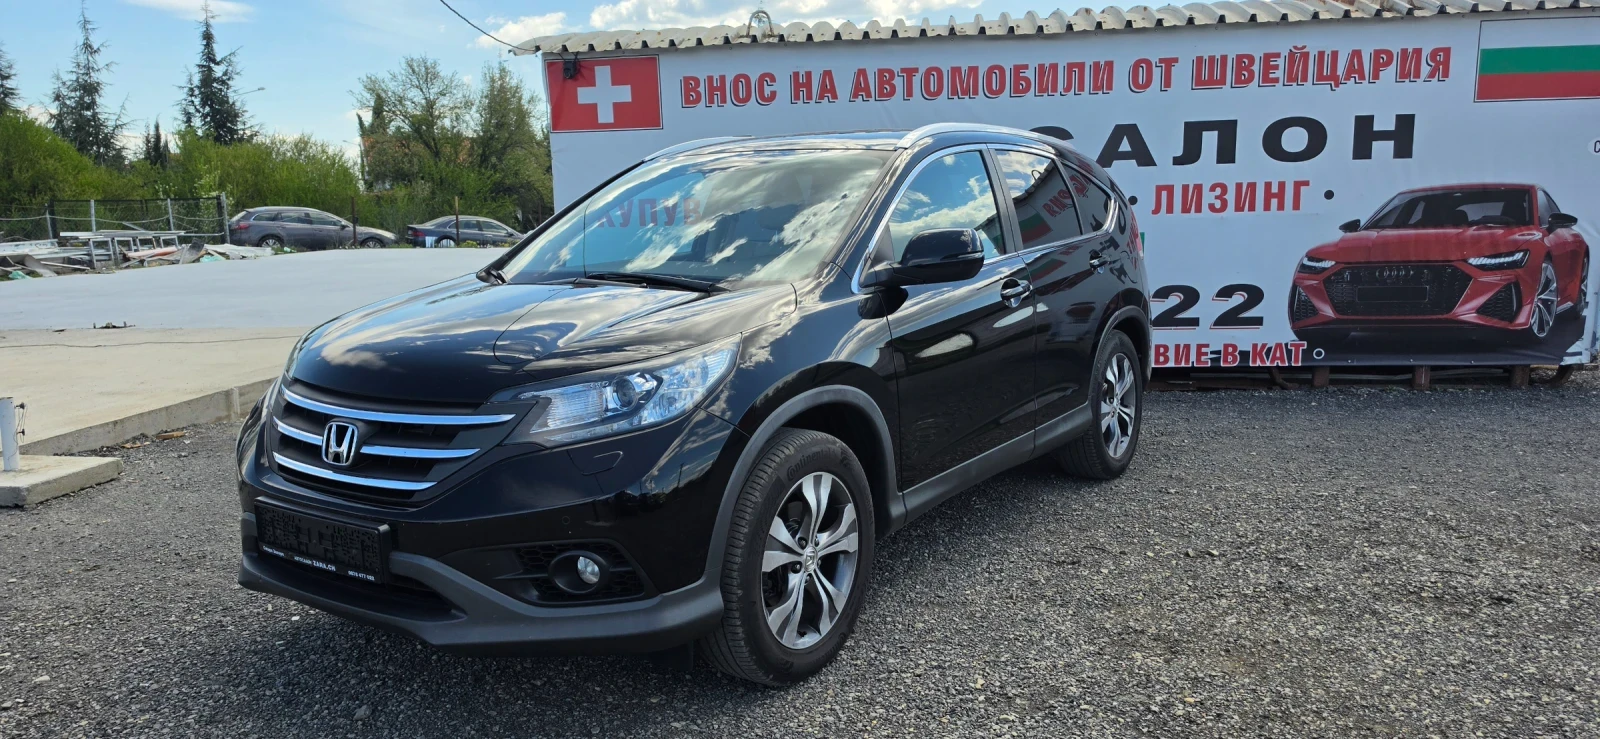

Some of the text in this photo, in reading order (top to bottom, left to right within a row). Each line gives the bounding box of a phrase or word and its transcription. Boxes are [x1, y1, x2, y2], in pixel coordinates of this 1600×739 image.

[680, 44, 1453, 108] ВНОС НА АВТОМОБИЛИ ОТ ШВЕЙЦАРИЯ
[1151, 179, 1310, 215] ЛИЗИНГ
[1153, 341, 1307, 367] ВИЕ В КАТ
